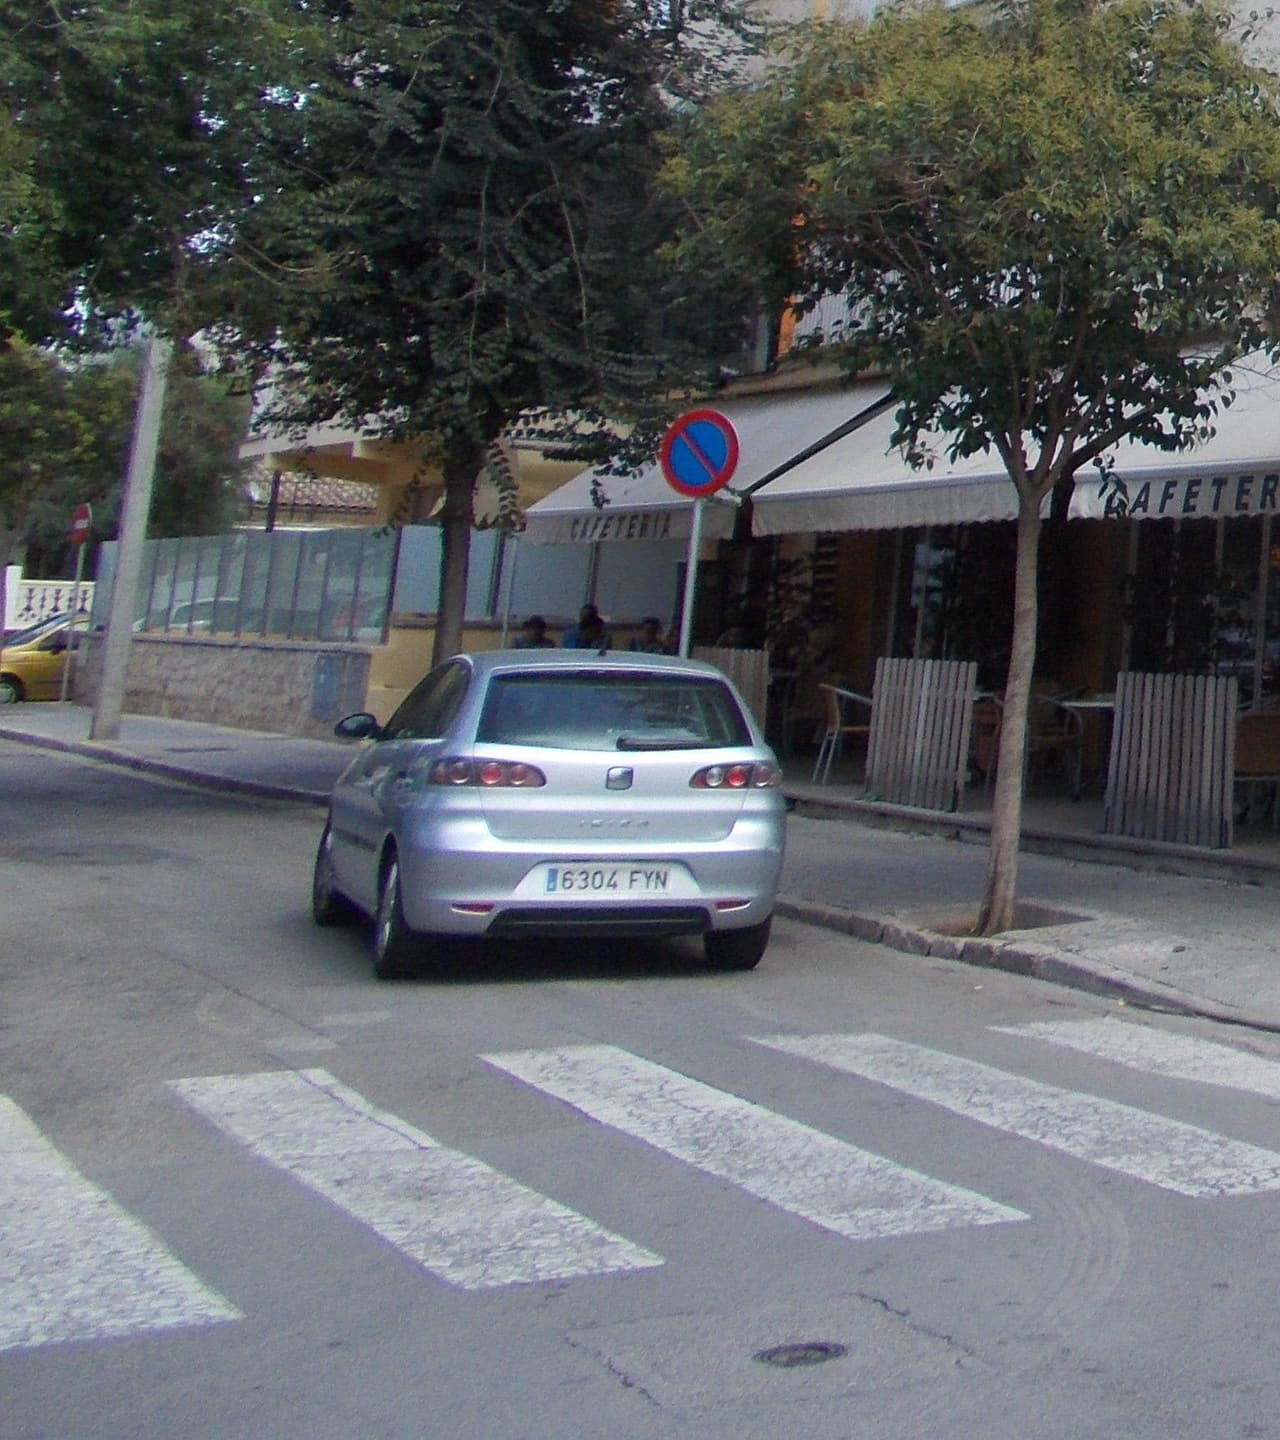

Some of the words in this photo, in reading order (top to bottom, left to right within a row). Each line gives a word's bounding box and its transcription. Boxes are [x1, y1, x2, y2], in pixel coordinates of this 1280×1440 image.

[571, 513, 671, 539] CAFETERIA
[562, 870, 618, 890] 6304
[629, 870, 668, 890] FYN
